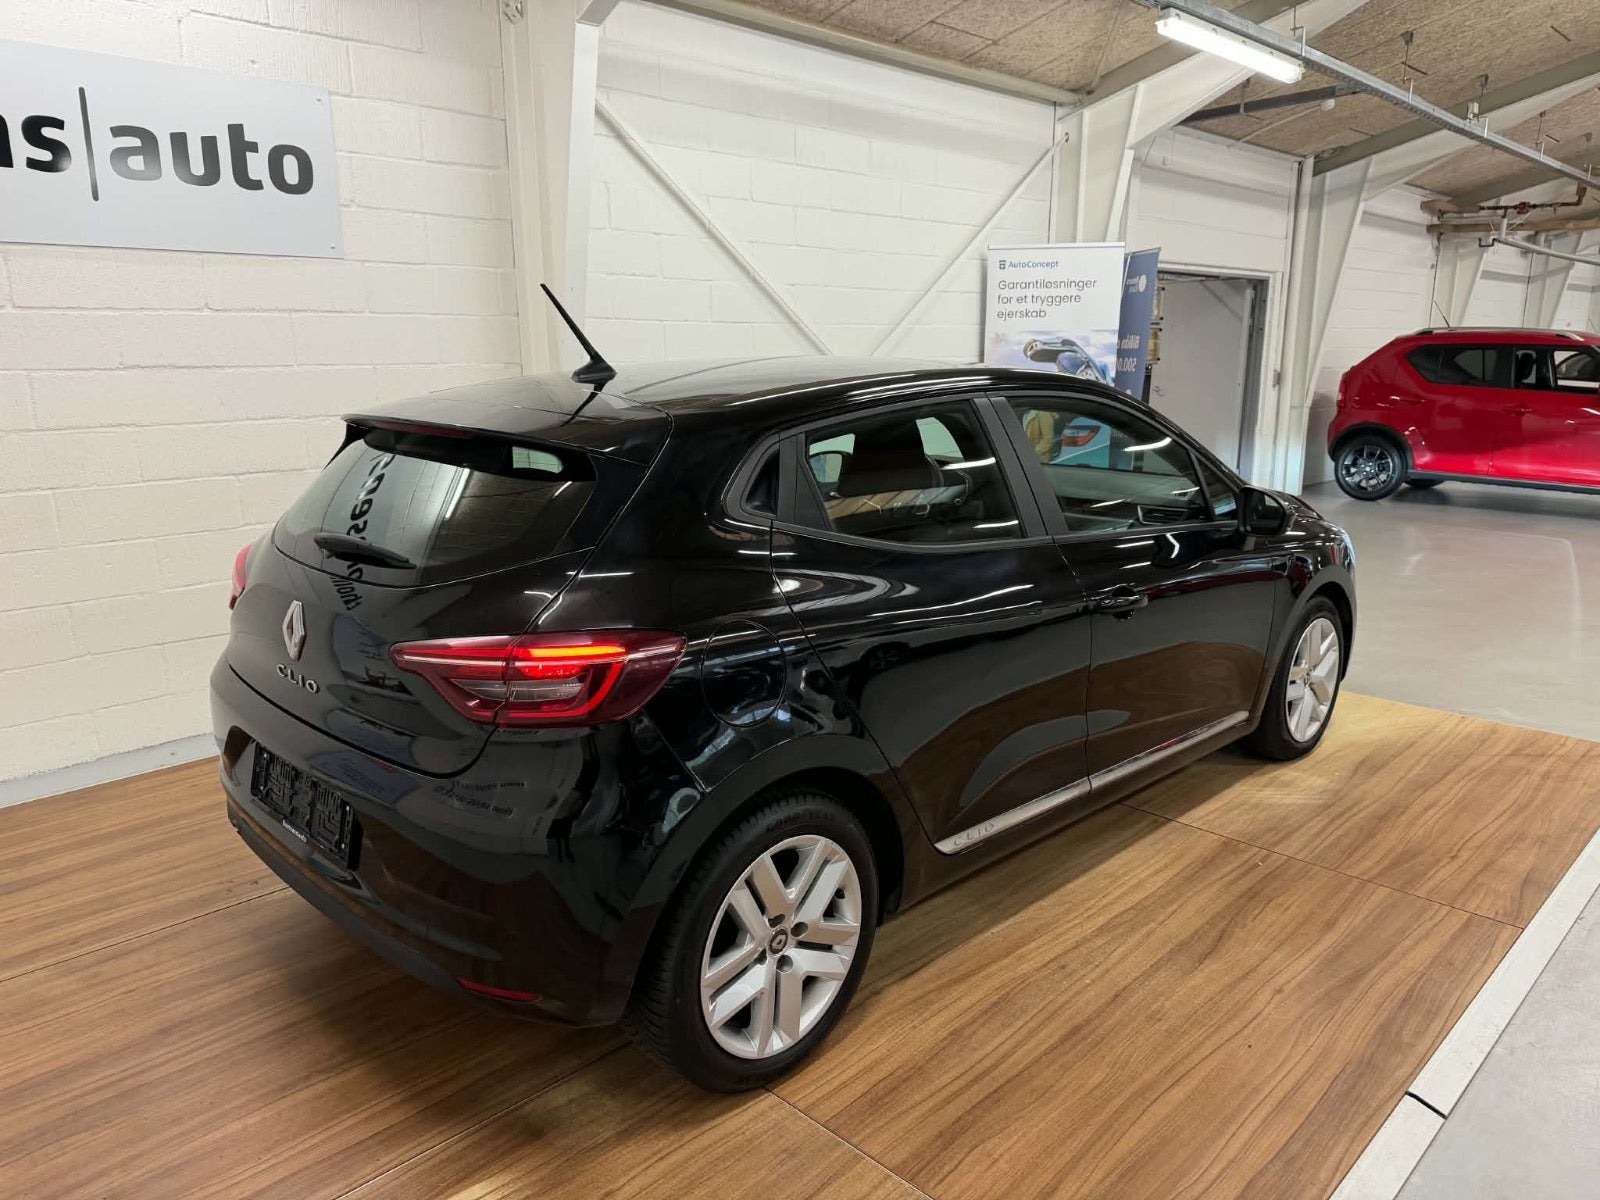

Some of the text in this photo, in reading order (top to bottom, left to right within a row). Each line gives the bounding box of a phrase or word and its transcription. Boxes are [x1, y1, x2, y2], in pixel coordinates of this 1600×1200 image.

[108, 123, 314, 195] auto
[1008, 260, 1059, 269] AutoConcept
[998, 278, 1097, 292] Garantiløsninger
[998, 294, 1081, 306] for et tryggere
[997, 308, 1047, 321] ejerskab
[276, 664, 320, 694] CLIO
[953, 822, 994, 847] CLIO
